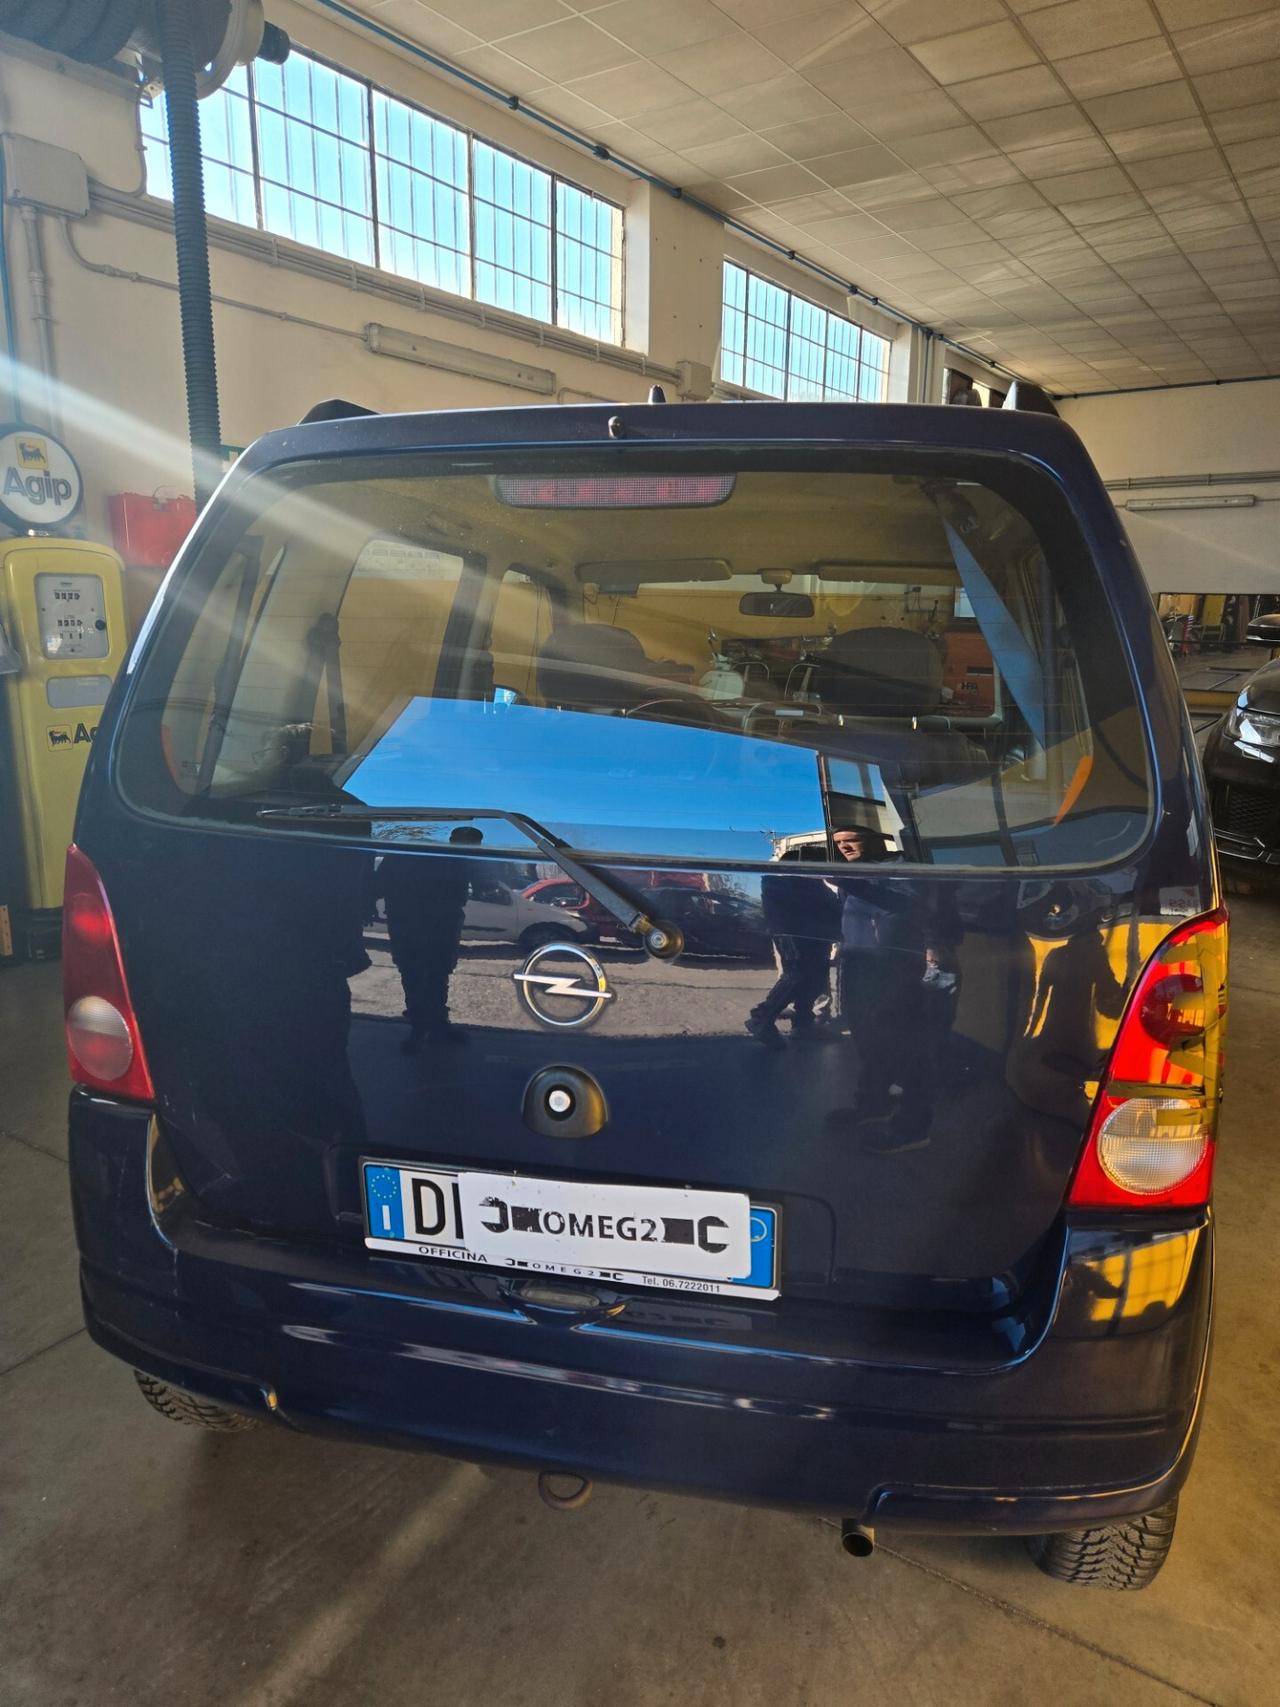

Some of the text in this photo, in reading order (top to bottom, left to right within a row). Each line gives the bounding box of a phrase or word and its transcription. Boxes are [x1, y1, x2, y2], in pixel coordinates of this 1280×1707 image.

[3, 466, 72, 506] Agip
[382, 1205, 391, 1230] I
[418, 1246, 488, 1263] OFFICINA
[642, 1275, 659, 1286] Tel.
[662, 1278, 721, 1293] 06.7222011
